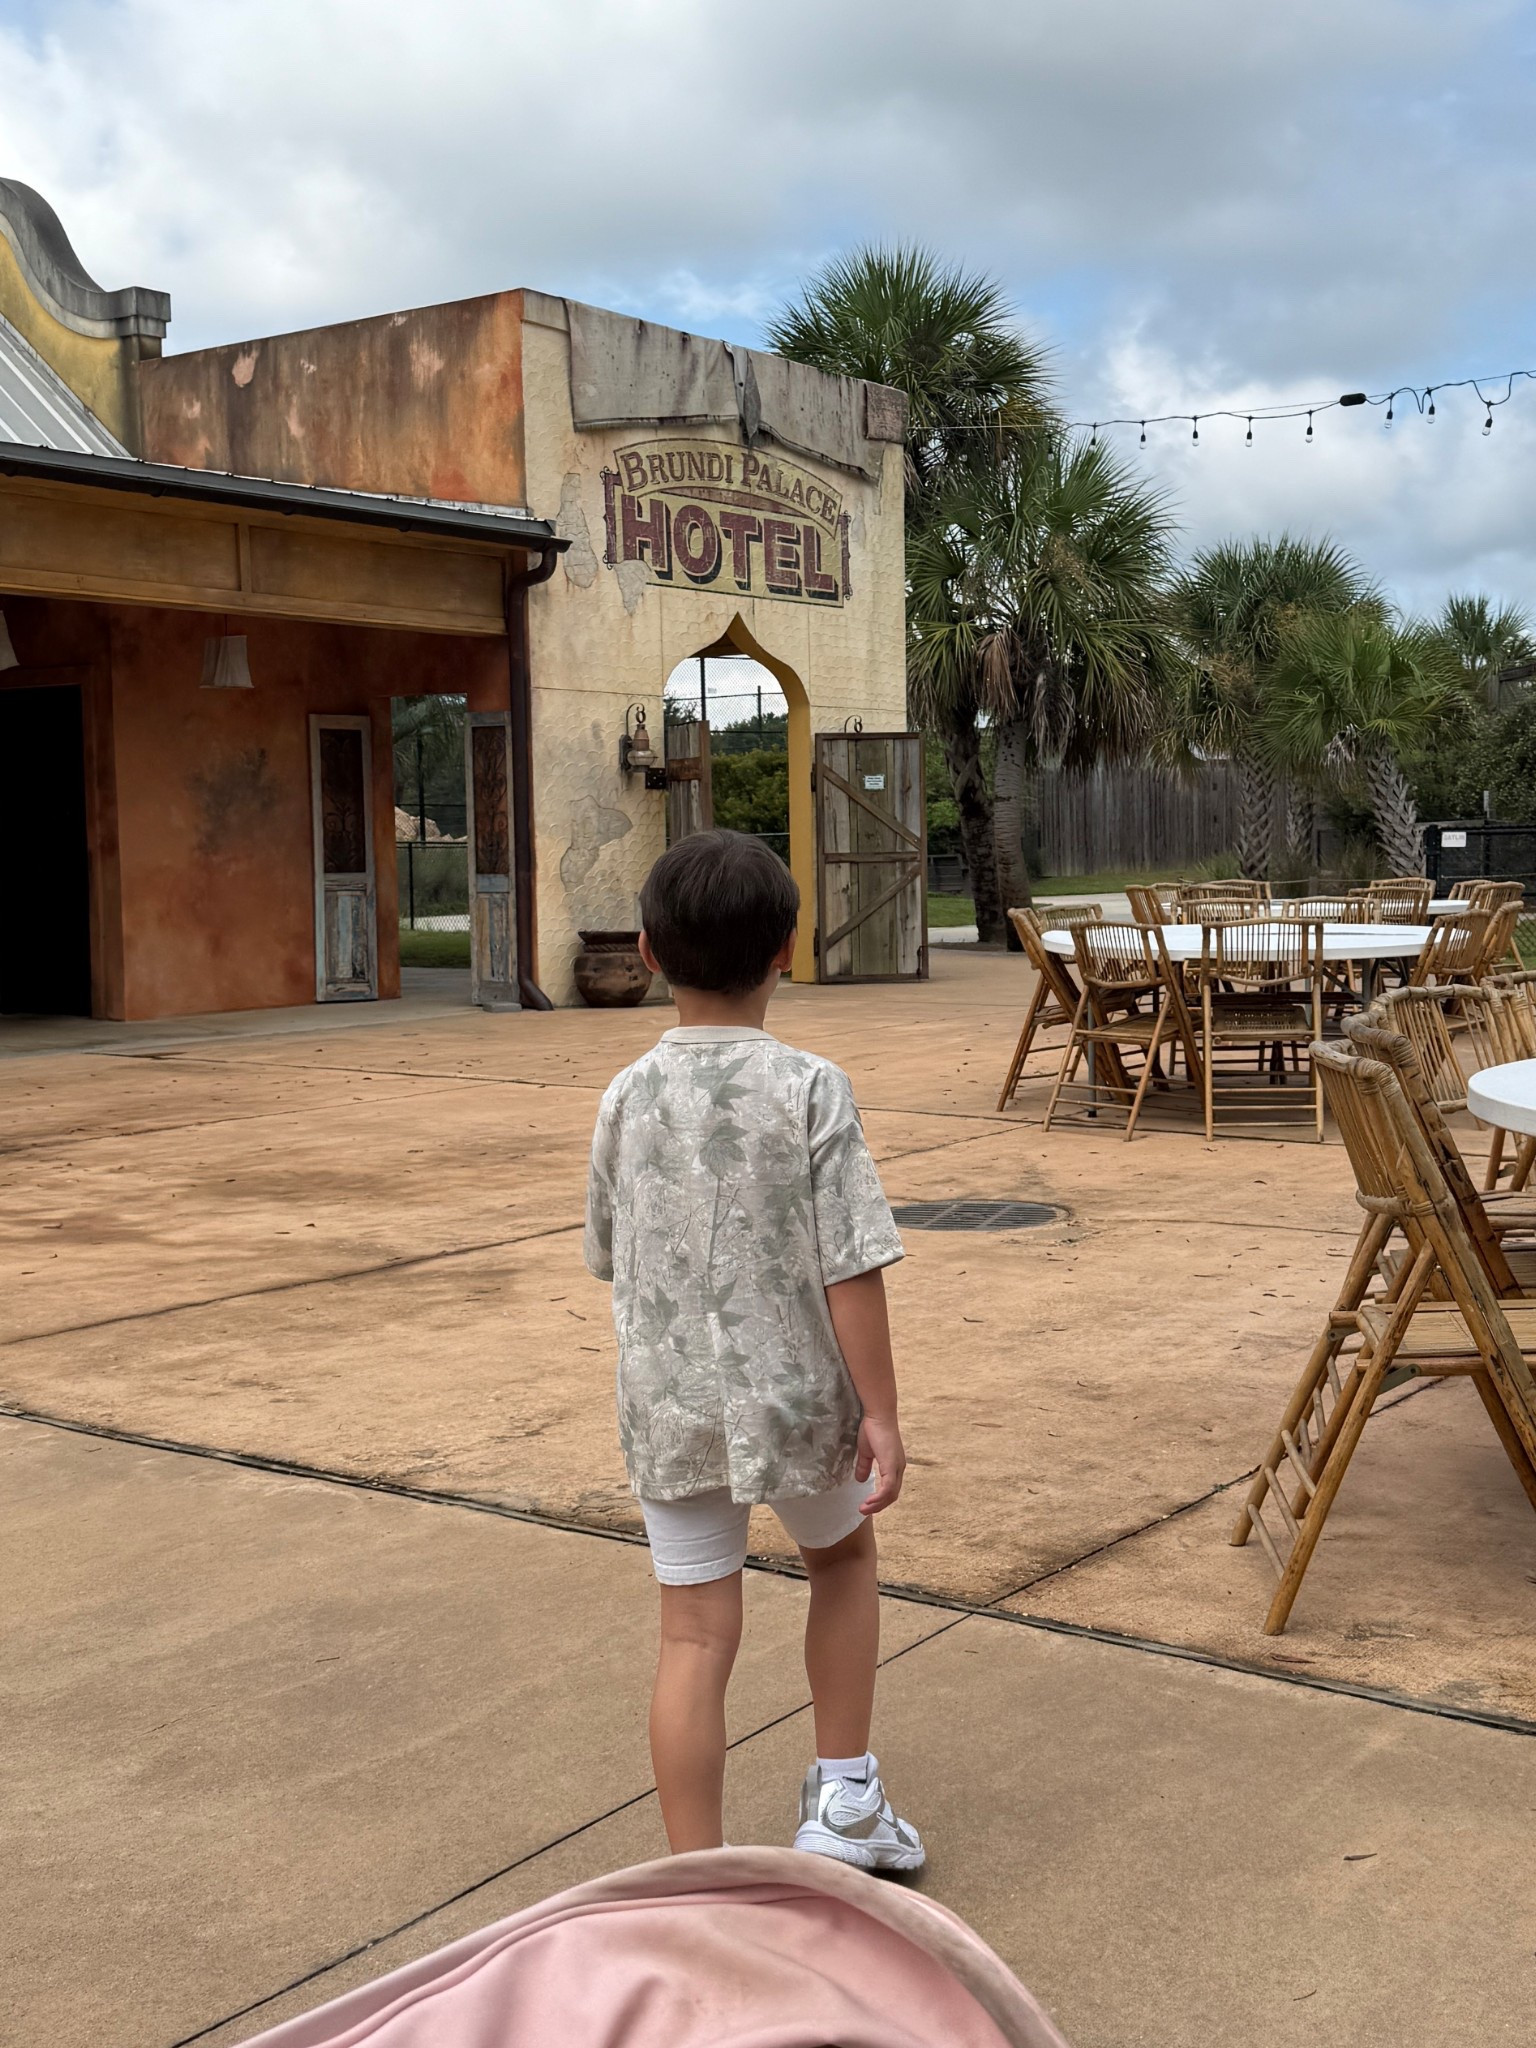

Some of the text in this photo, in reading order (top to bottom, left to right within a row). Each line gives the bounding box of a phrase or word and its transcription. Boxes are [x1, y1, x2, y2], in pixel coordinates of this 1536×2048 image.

[620, 451, 838, 525] BRUNDI PALACE
[621, 494, 839, 601] HOTEL
